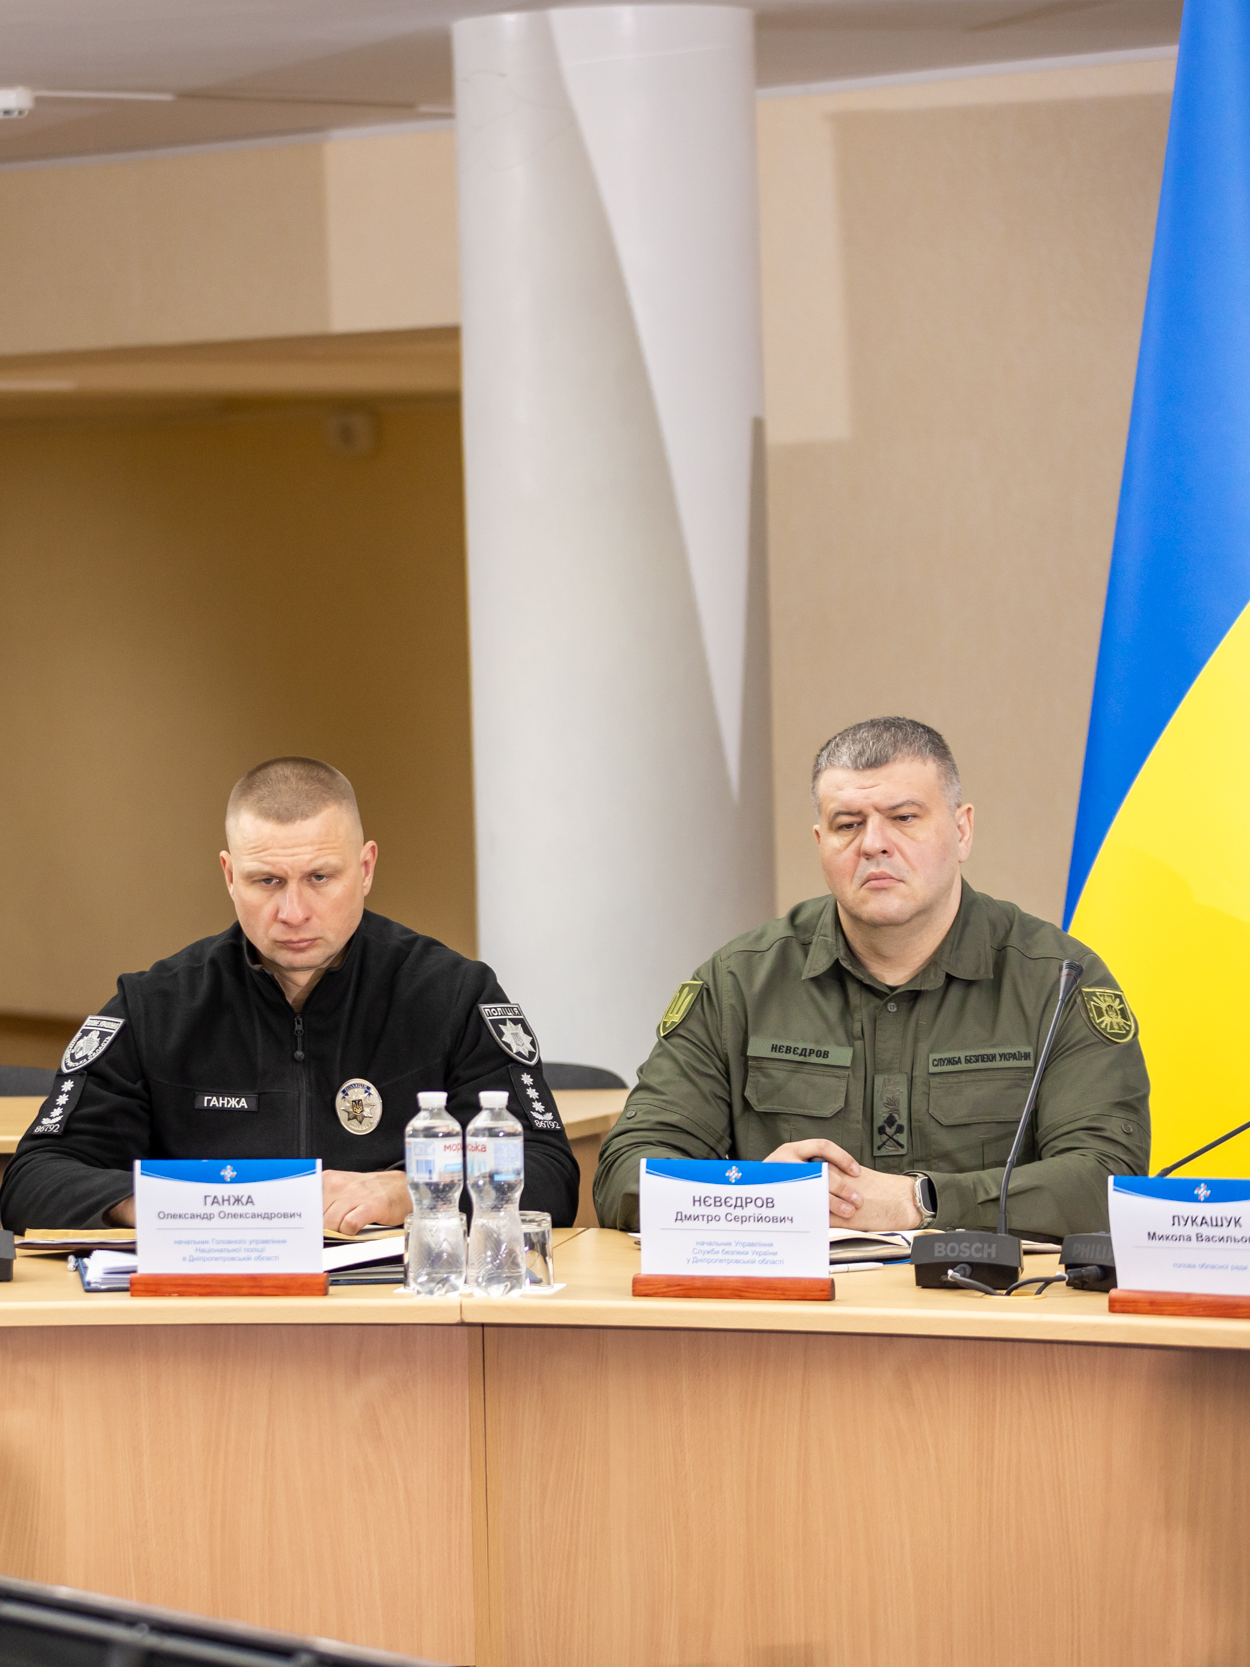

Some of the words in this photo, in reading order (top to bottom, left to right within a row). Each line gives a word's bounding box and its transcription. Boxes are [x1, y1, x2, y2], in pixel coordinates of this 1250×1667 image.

[484, 1007, 521, 1017] ПОЛІЦІЯ
[770, 1043, 830, 1059] НЄВЄДРОВ
[932, 1056, 962, 1067] СЛУЖБА
[964, 1053, 997, 1064] БЕЗПЕКИ
[998, 1050, 1031, 1062] УКРАЇНИ
[203, 1096, 248, 1109] ГАНЖА
[534, 1120, 561, 1129] 86792
[203, 1194, 255, 1207] ГАНЖА
[692, 1195, 775, 1210] НЄВЄДРОВ
[157, 1210, 216, 1221] Олександр
[218, 1210, 302, 1221] Олександрович
[674, 1211, 721, 1225] Дмитро
[724, 1212, 794, 1225] Сергійович
[1171, 1214, 1243, 1229] ЛУКАШУК
[1147, 1231, 1192, 1242] Микола
[933, 1242, 997, 1258] BOSCH
